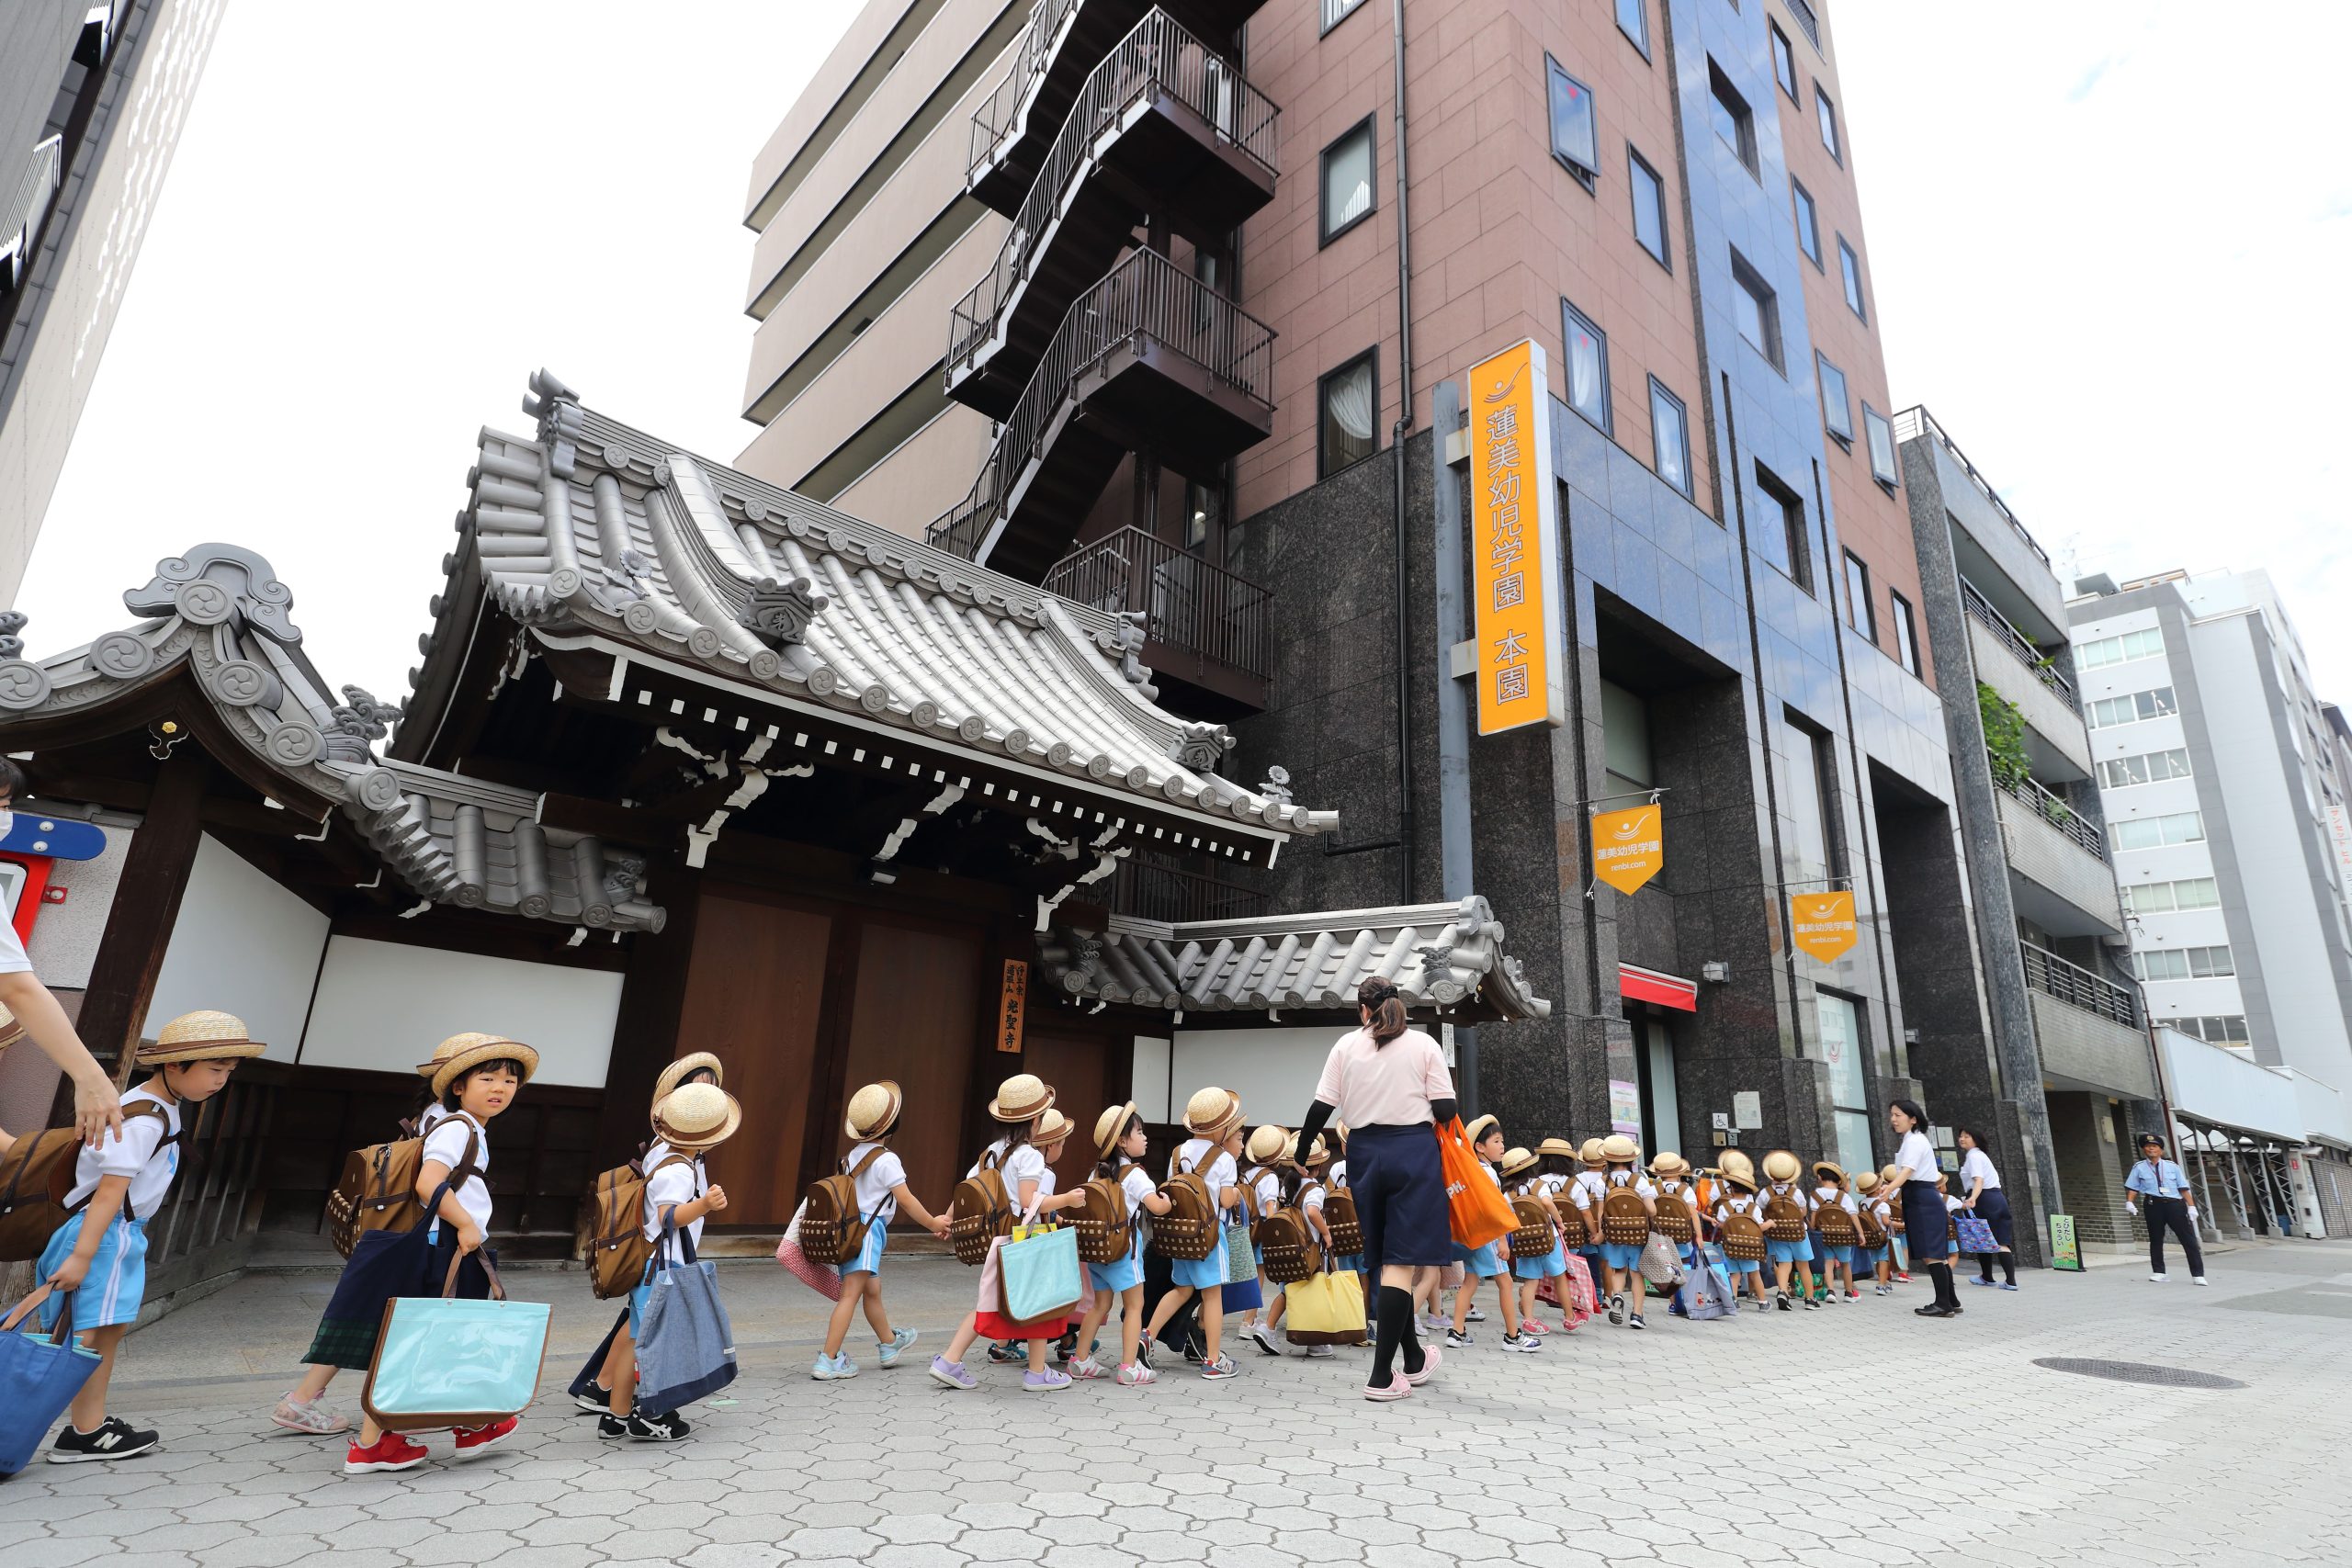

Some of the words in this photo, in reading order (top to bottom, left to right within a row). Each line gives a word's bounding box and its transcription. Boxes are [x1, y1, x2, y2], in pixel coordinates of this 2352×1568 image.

[1487, 404, 1525, 613] 蓮美幼児学園
[1494, 629, 1530, 705] 本園
[1597, 840, 1659, 861] 蓮美幼児学園
[1611, 861, 1646, 872] renbi.com
[1796, 920, 1853, 933] 蓮美幼児学園
